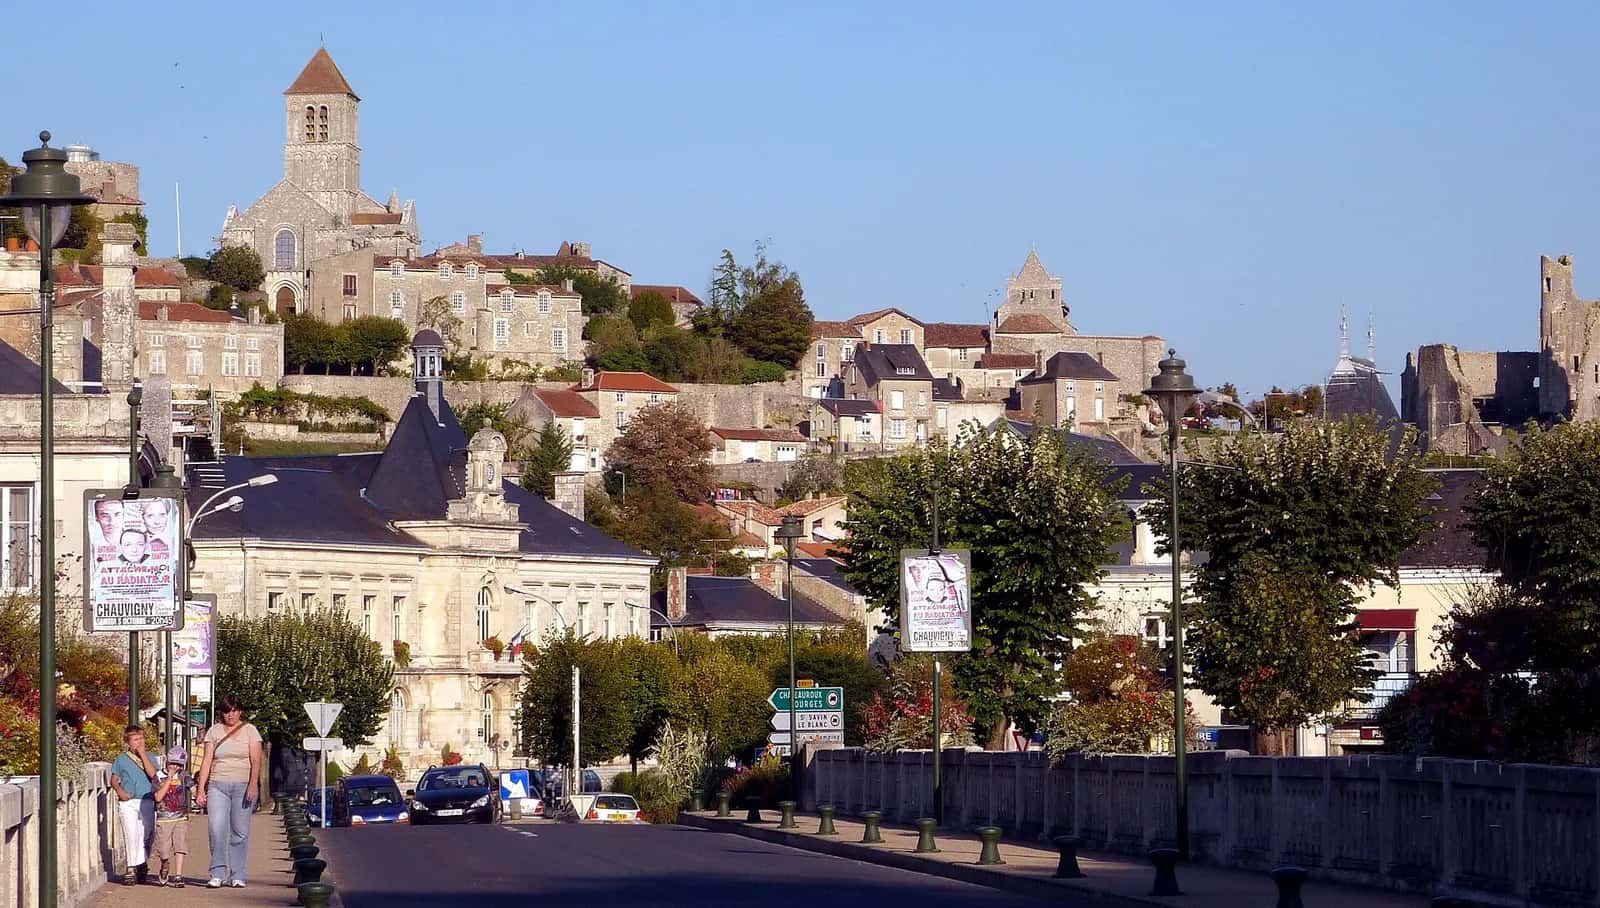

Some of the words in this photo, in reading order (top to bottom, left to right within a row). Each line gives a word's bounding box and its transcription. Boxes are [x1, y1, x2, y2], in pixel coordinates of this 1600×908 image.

[101, 577, 114, 585] AU
[97, 603, 154, 617] CHAUVIGNY
[913, 631, 955, 641] CHAUVIGNY
